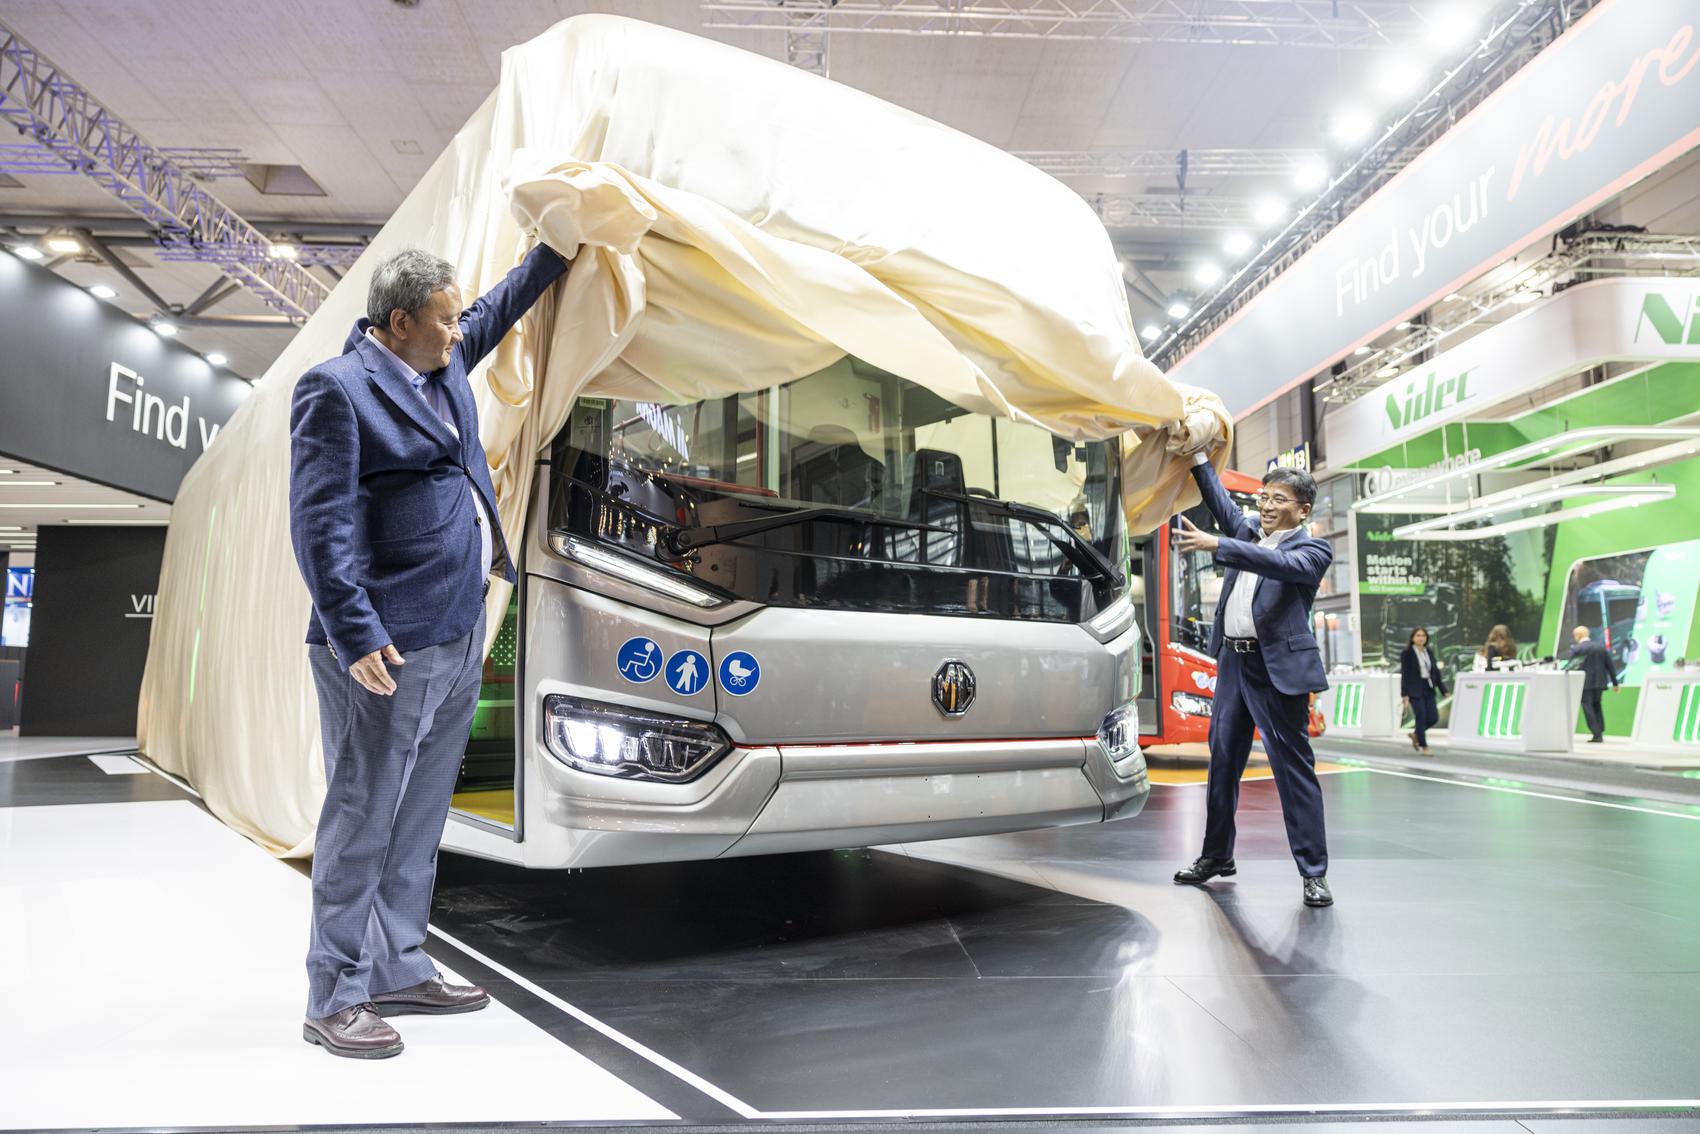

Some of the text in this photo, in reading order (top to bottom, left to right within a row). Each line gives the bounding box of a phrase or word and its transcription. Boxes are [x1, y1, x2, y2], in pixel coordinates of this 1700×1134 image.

[1335, 24, 1700, 316] Find your more
[106, 361, 190, 449] Find
[1382, 364, 1480, 438] Nidec
[1366, 554, 1412, 566] Motion
[1366, 565, 1408, 577] starts
[1408, 574, 1423, 585] to
